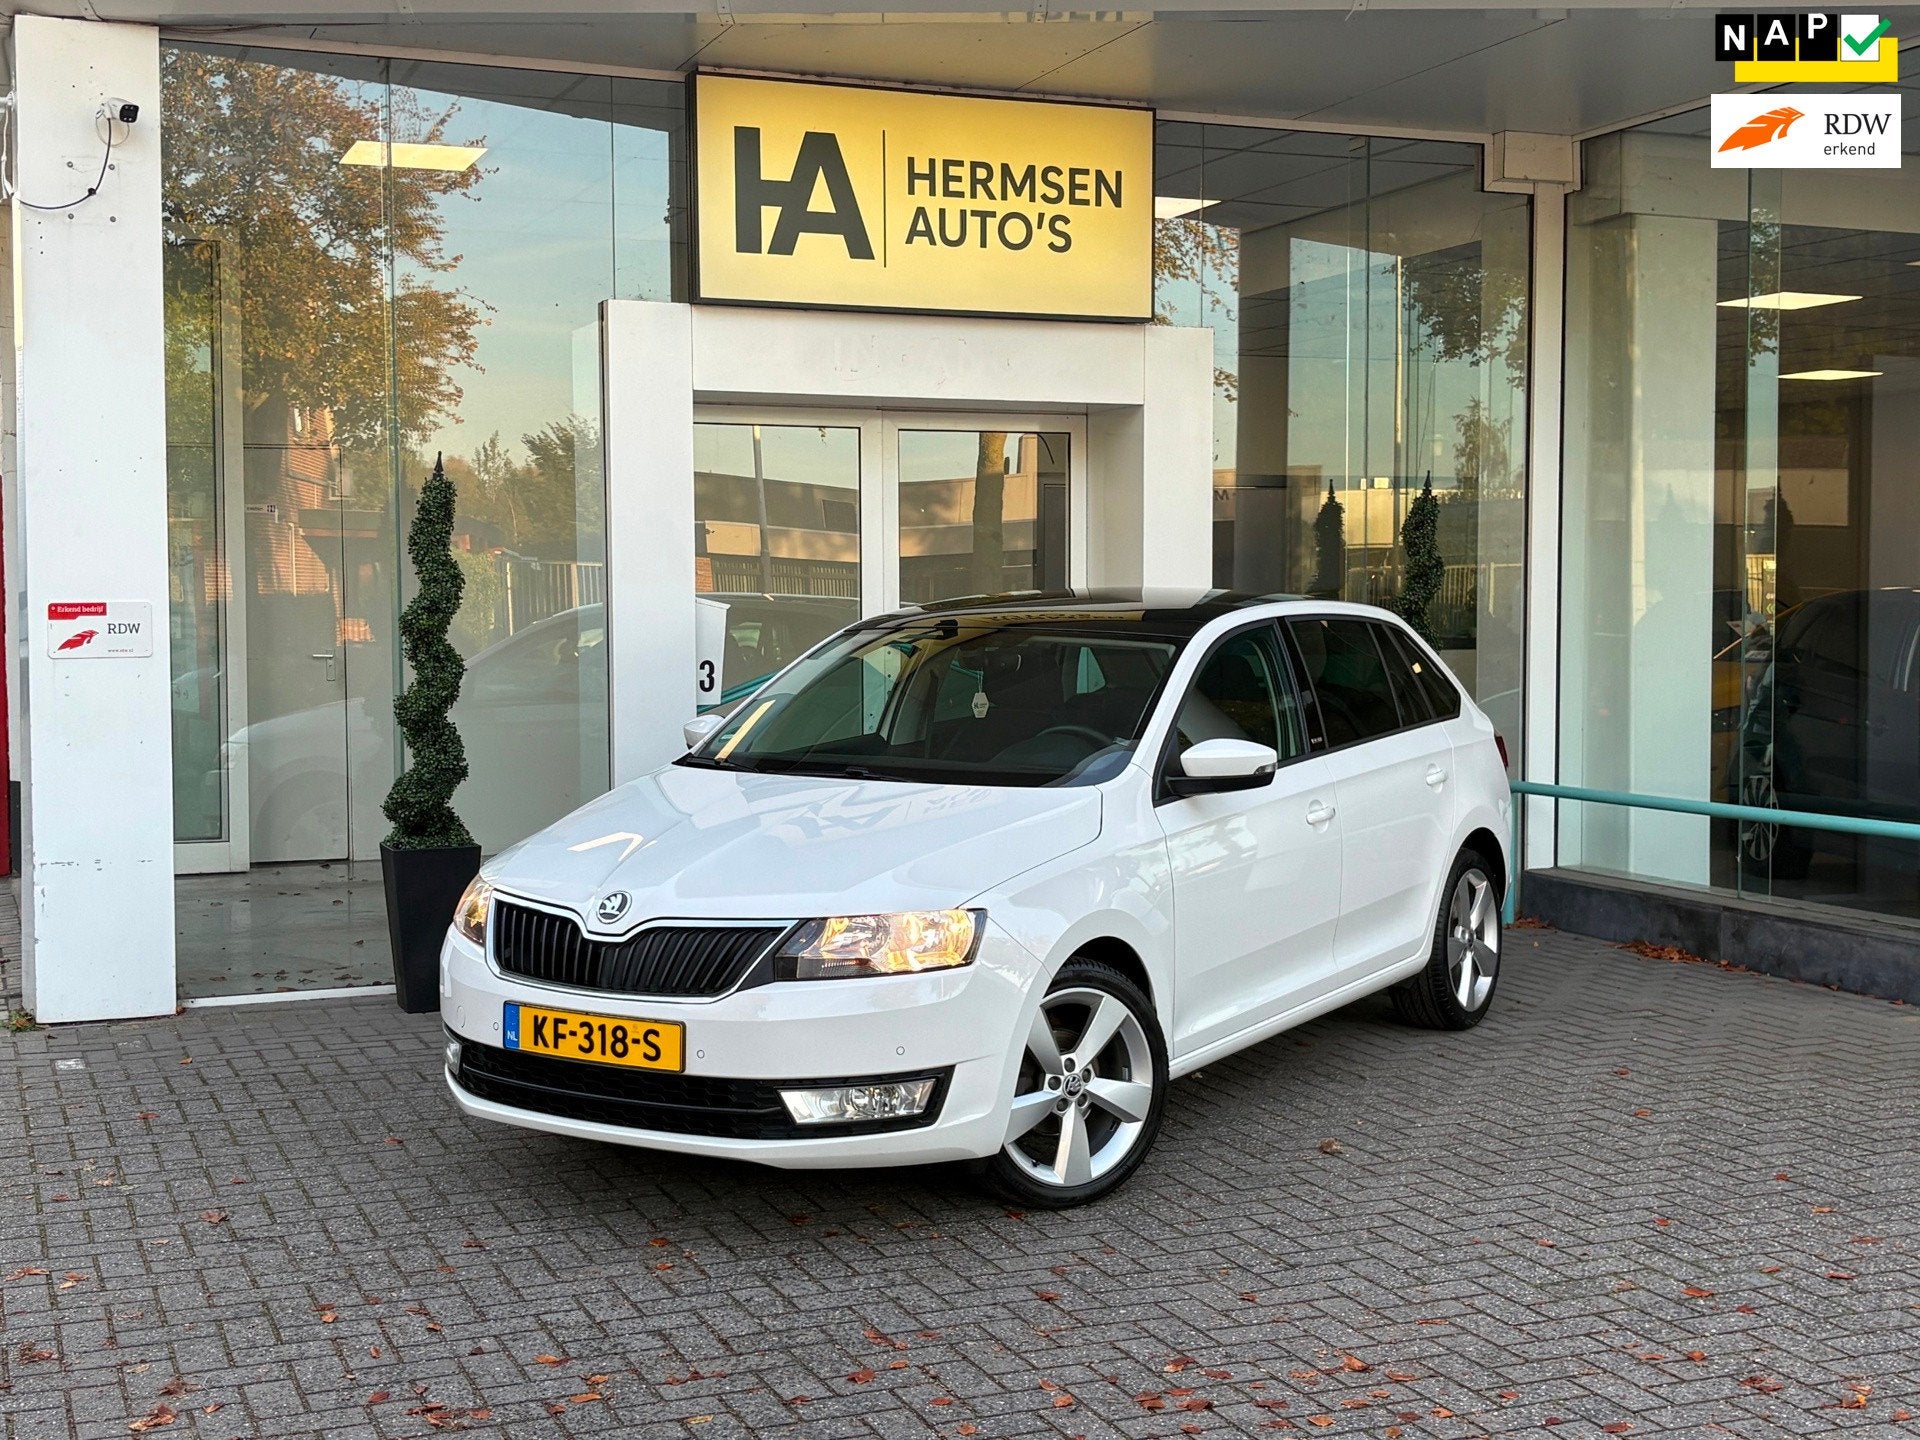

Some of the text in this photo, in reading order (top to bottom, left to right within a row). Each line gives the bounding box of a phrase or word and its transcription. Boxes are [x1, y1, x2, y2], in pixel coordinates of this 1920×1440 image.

[733, 125, 876, 261] HA
[906, 156, 1123, 209] HERMSEN
[904, 206, 1073, 254] AUTO'S
[57, 605, 104, 614] Erkend bedrijf
[107, 623, 141, 635] RDW
[699, 659, 715, 693] 3
[507, 1014, 662, 1062] NL KF-318-S
